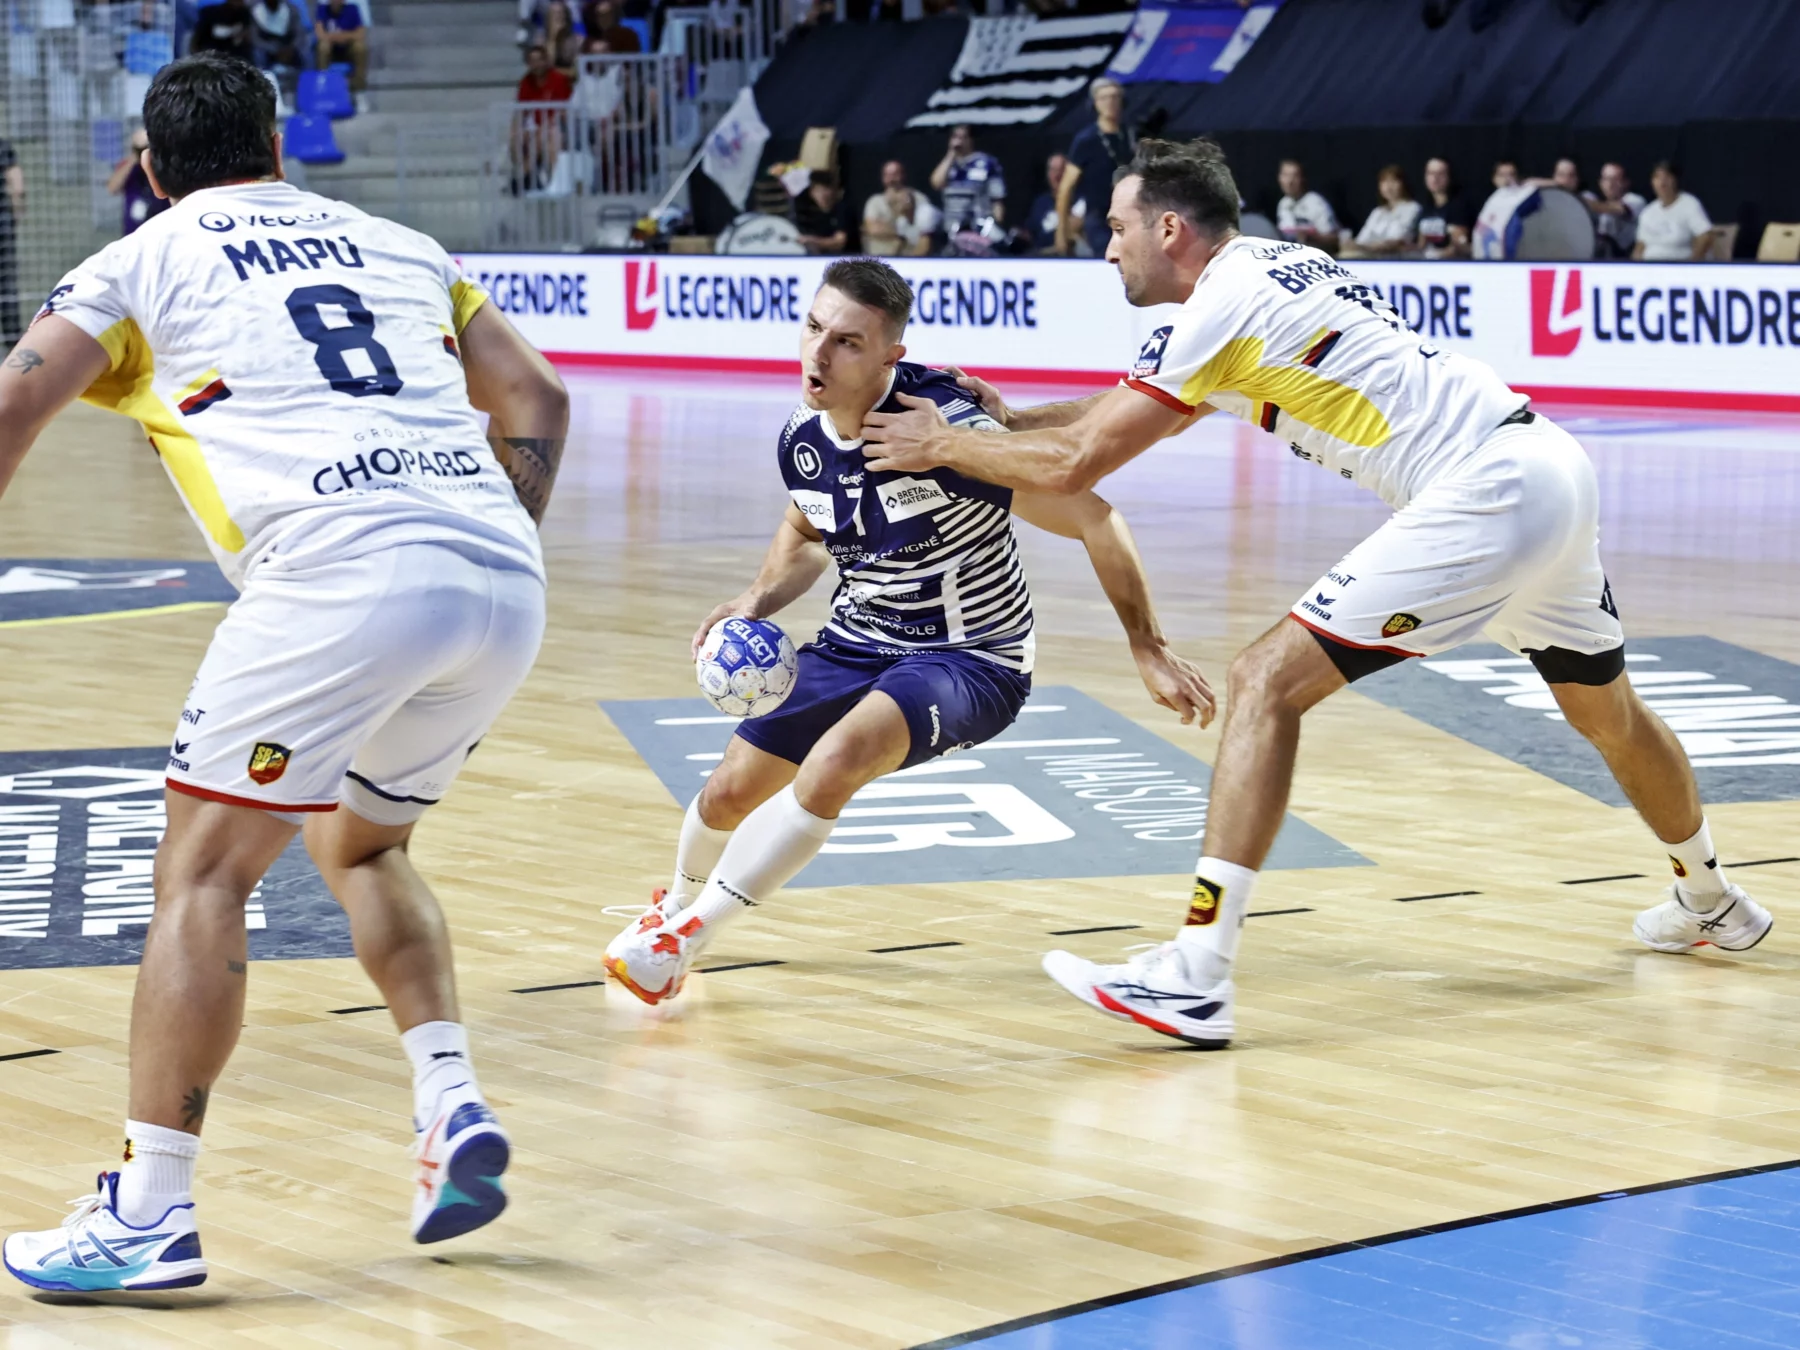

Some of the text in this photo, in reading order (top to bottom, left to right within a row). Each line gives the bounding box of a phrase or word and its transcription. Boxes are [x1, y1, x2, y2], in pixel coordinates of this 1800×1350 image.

[222, 235, 365, 281] MAPU
[478, 273, 588, 316] GENDRE
[664, 275, 800, 321] LEGENDRE
[1593, 286, 1800, 346] LEGENDRE
[284, 283, 404, 397] 8
[313, 448, 481, 495] CHOPARD
[845, 487, 867, 537] 7
[851, 544, 863, 552] de
[1301, 600, 1333, 621] erima
[725, 619, 776, 665] SELECT
